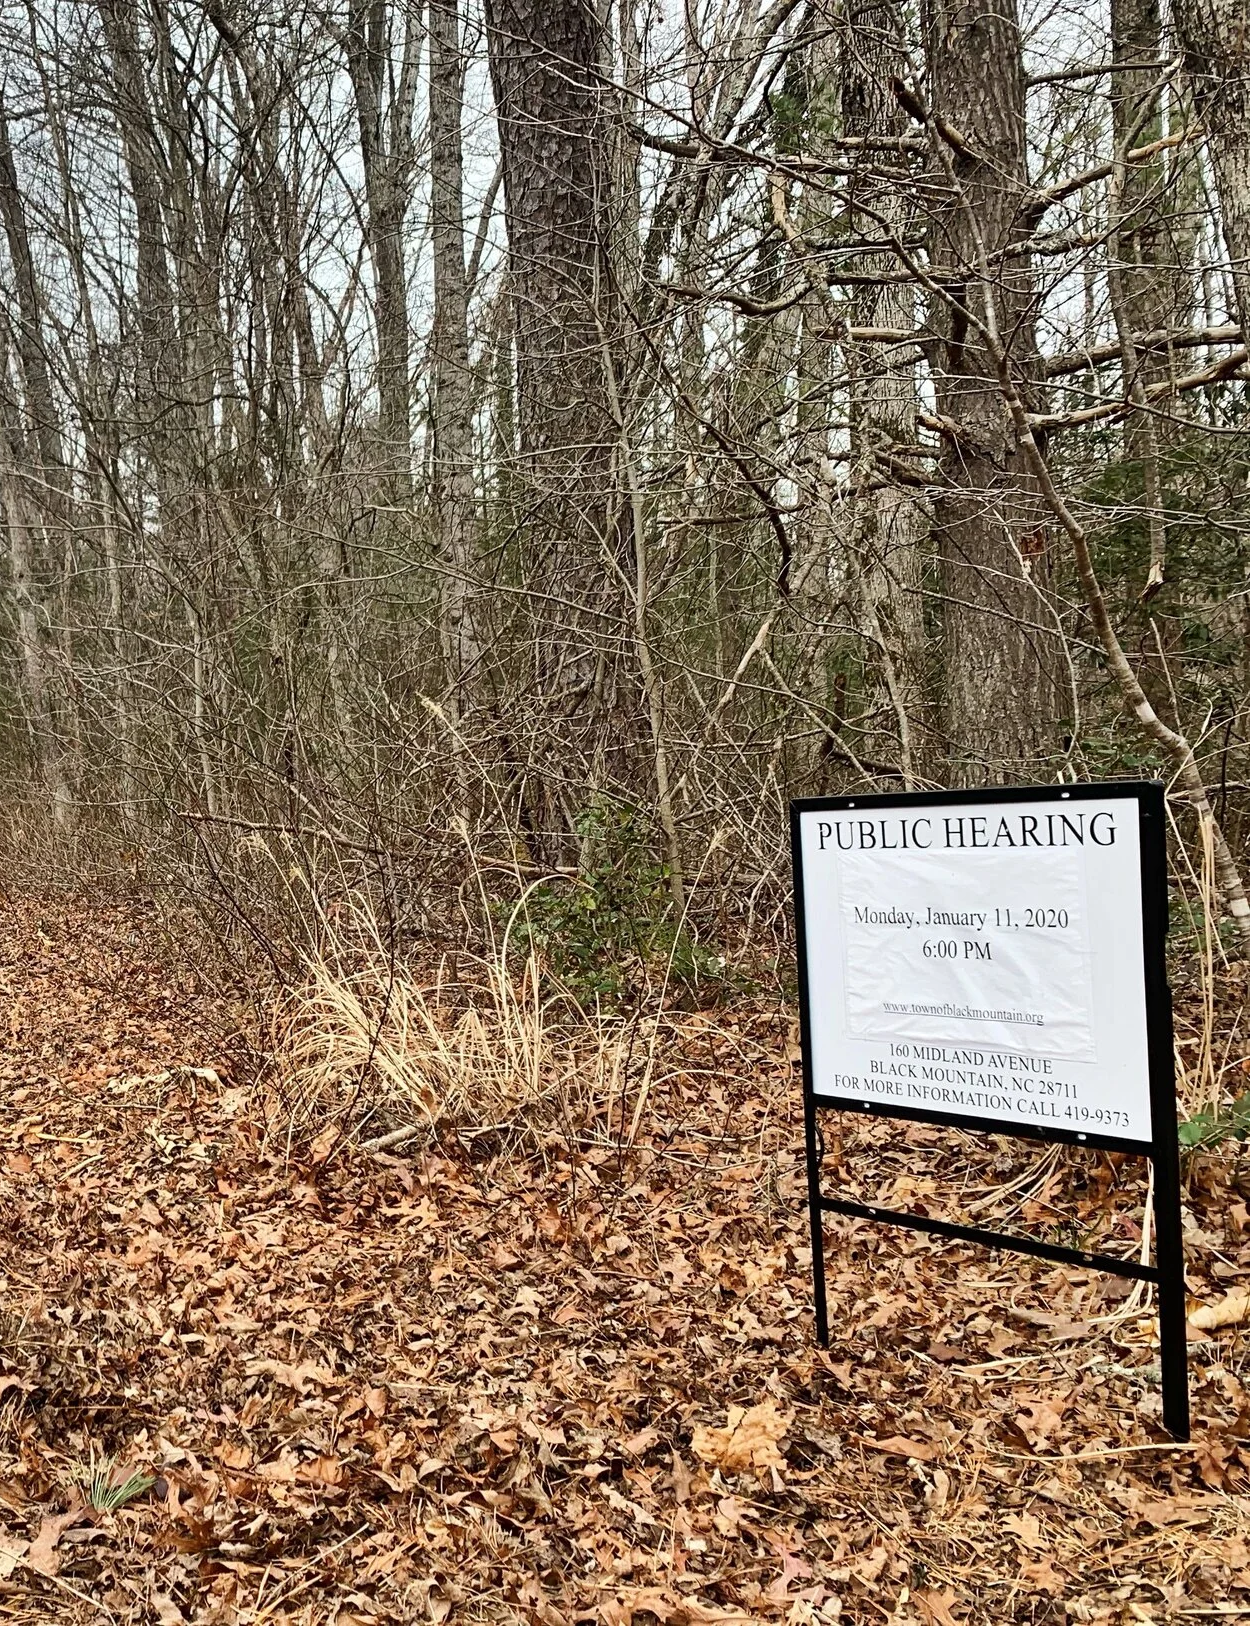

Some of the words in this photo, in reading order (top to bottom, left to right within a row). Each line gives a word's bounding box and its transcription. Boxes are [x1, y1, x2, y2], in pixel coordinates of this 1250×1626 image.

[817, 818, 933, 850] PUBLIC
[943, 812, 1118, 848] HEARING
[853, 906, 920, 928] Monday,
[925, 907, 987, 931] January
[994, 908, 1019, 930] 11,
[1025, 908, 1068, 928] 2020
[922, 939, 958, 959] 6:00
[963, 941, 992, 960] PM
[883, 1001, 1044, 1025] www.townofblackmountain.org
[889, 1043, 910, 1058] 160
[913, 1045, 984, 1067] MIDLAND
[988, 1055, 1053, 1074] AVENUE
[870, 1059, 918, 1079] BLACK
[922, 1066, 1008, 1092] MOUNTAIN,
[1012, 1077, 1036, 1094] NC
[1038, 1080, 1078, 1099] 28711
[834, 1074, 861, 1090] FOR
[863, 1078, 904, 1096] MORE
[907, 1084, 1013, 1111] INFORMATION
[1017, 1099, 1060, 1118] CALL
[1064, 1104, 1130, 1128] 419-9373
